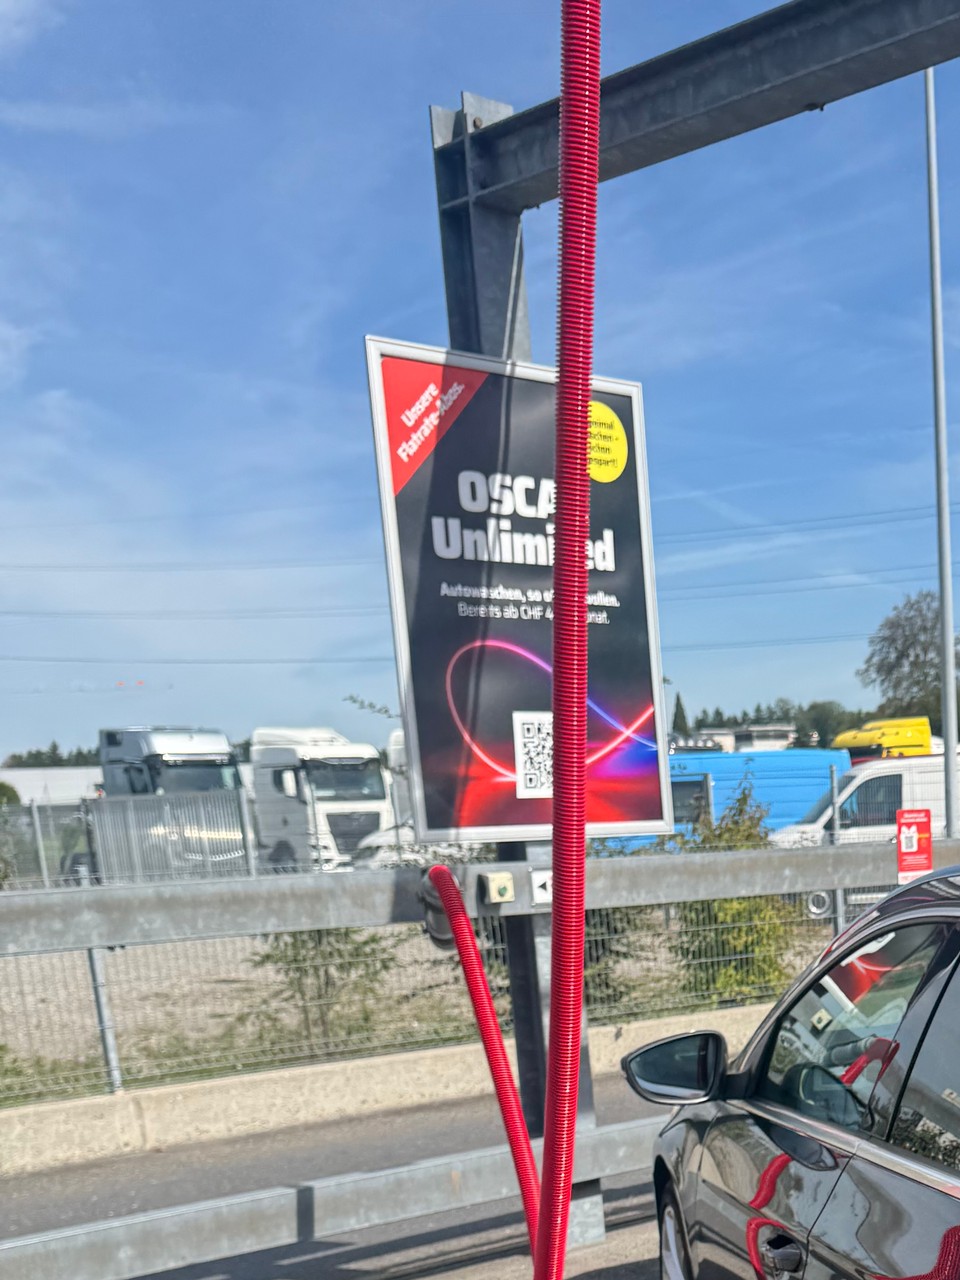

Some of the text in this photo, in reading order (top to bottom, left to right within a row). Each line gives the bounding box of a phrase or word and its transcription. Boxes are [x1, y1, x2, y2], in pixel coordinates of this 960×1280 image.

[400, 382, 439, 427] Unsere
[458, 470, 556, 518] OSCA
[431, 516, 615, 571] Unlimied
[440, 581, 526, 603] Autowaschen,
[527, 588, 542, 601] so
[457, 601, 502, 618] Bereits
[503, 603, 519, 619] ab
[520, 604, 543, 620] CHF
